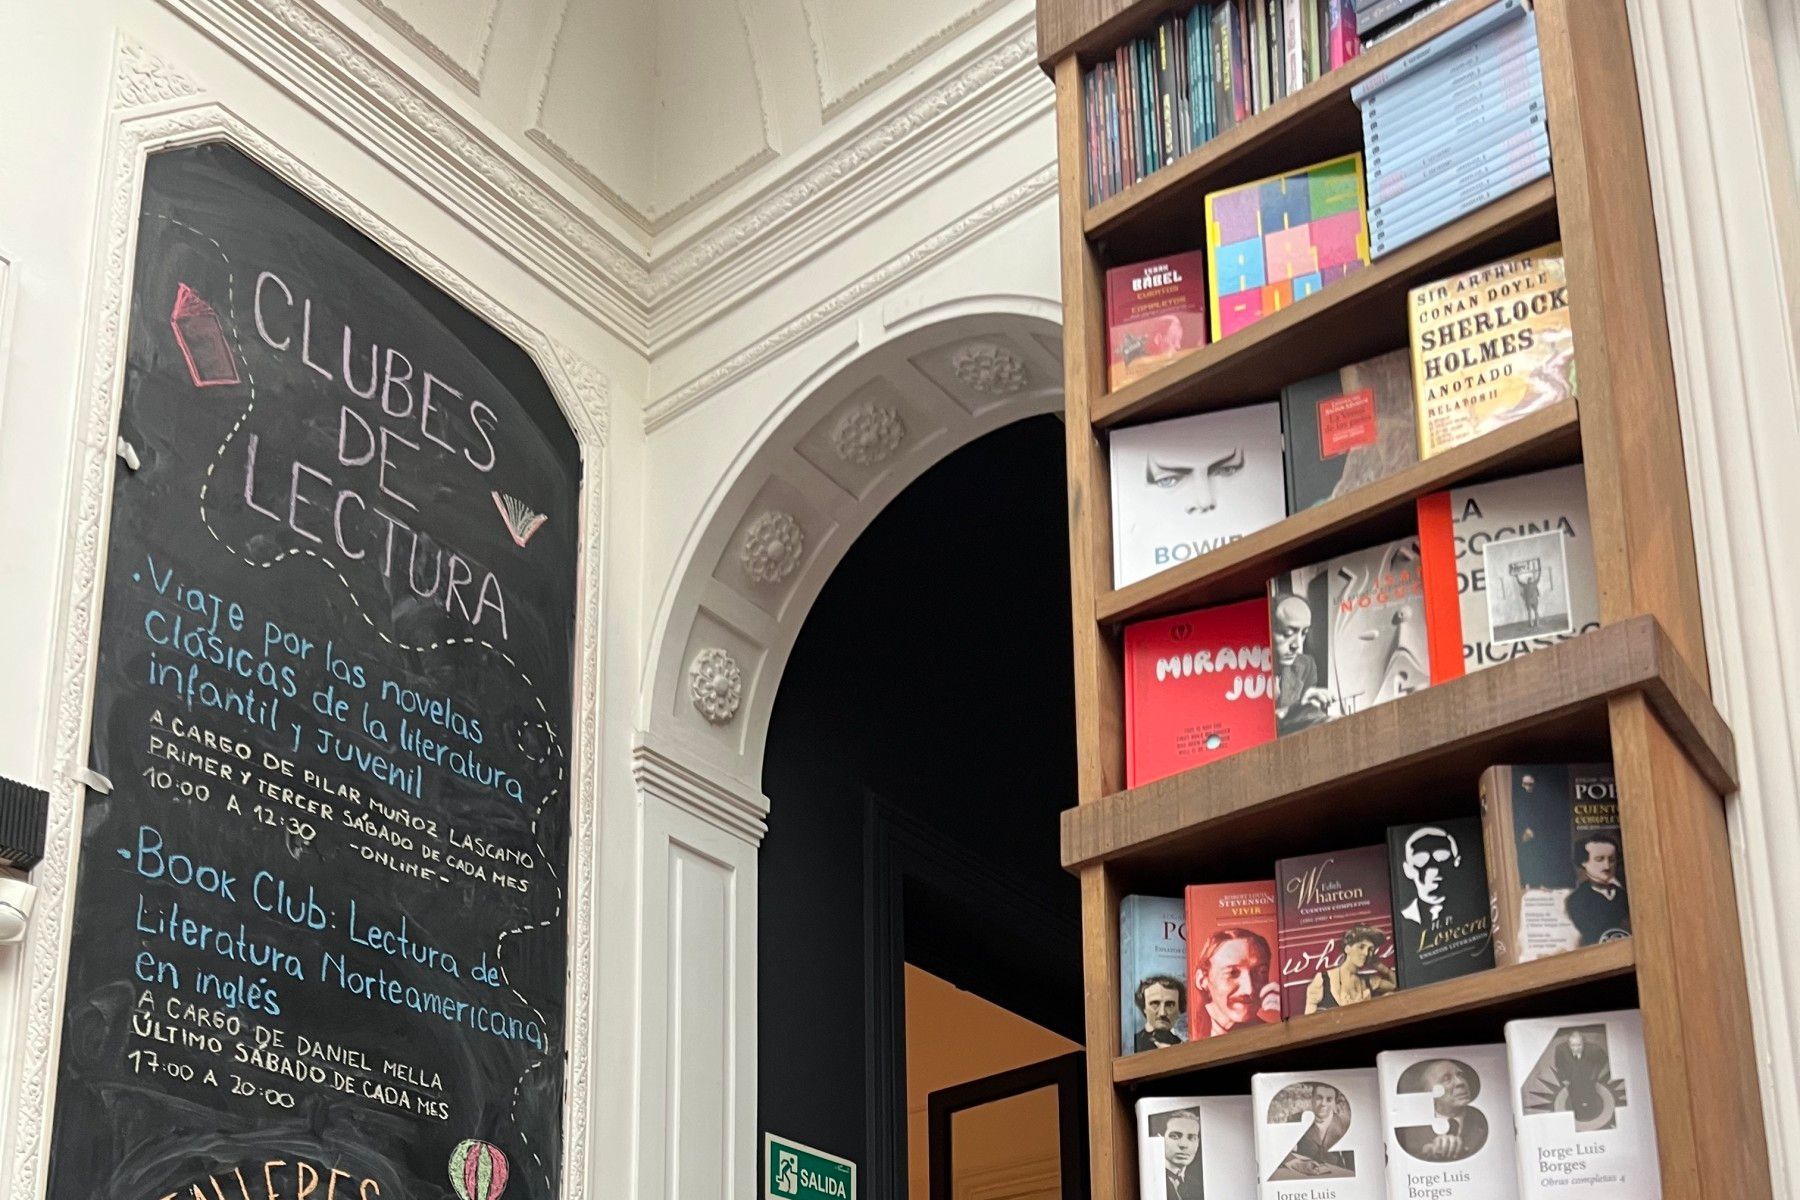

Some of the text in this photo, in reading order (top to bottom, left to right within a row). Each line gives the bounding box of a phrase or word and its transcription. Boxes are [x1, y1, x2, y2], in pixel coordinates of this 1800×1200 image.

[1132, 270, 1183, 292] BABEL
[1419, 272, 1548, 324] CONAN DOYLE
[1421, 286, 1569, 352] SHERLOCK
[254, 271, 498, 472] CLUBES
[1424, 327, 1535, 381] HOLMES
[1427, 364, 1513, 401] ANOTADO
[338, 405, 420, 512] DE
[244, 433, 508, 640] LECTURA
[149, 652, 279, 731] infantil
[265, 621, 314, 660] por
[326, 640, 366, 688] las
[381, 679, 483, 744] novelas
[312, 685, 349, 722] de
[362, 701, 388, 743] la
[400, 718, 524, 804] literatura
[142, 765, 210, 802] 10:00
[226, 794, 242, 816] A
[253, 804, 316, 841] 12:30
[149, 708, 534, 869] A CARGO DE PILAR MUÑOZ LASCANO
[149, 734, 232, 782] PRIMER
[257, 777, 333, 822] TERCER
[342, 809, 414, 851] SÁBADO
[421, 843, 440, 862] DE
[446, 854, 487, 882] CADA
[491, 871, 530, 893] MES
[137, 824, 236, 902] Book
[350, 899, 460, 978] Lectura
[471, 951, 500, 987] de
[1231, 906, 1262, 916] VIVIR
[135, 951, 281, 1016] en inglés
[136, 893, 542, 1050] Literatura Norteamericana
[132, 1011, 449, 1120] ÚLTIMO SÁBADO DE CADA MES
[138, 989, 443, 1092] A CARGO DE DANIEL MELLA
[128, 1050, 295, 1108] 17:00 A 20:00
[800, 1168, 846, 1199] SALIDA
[1311, 1188, 1336, 1200] Luis
[1407, 1170, 1470, 1186] Jorge Luis
[1409, 1187, 1452, 1200] Borges
